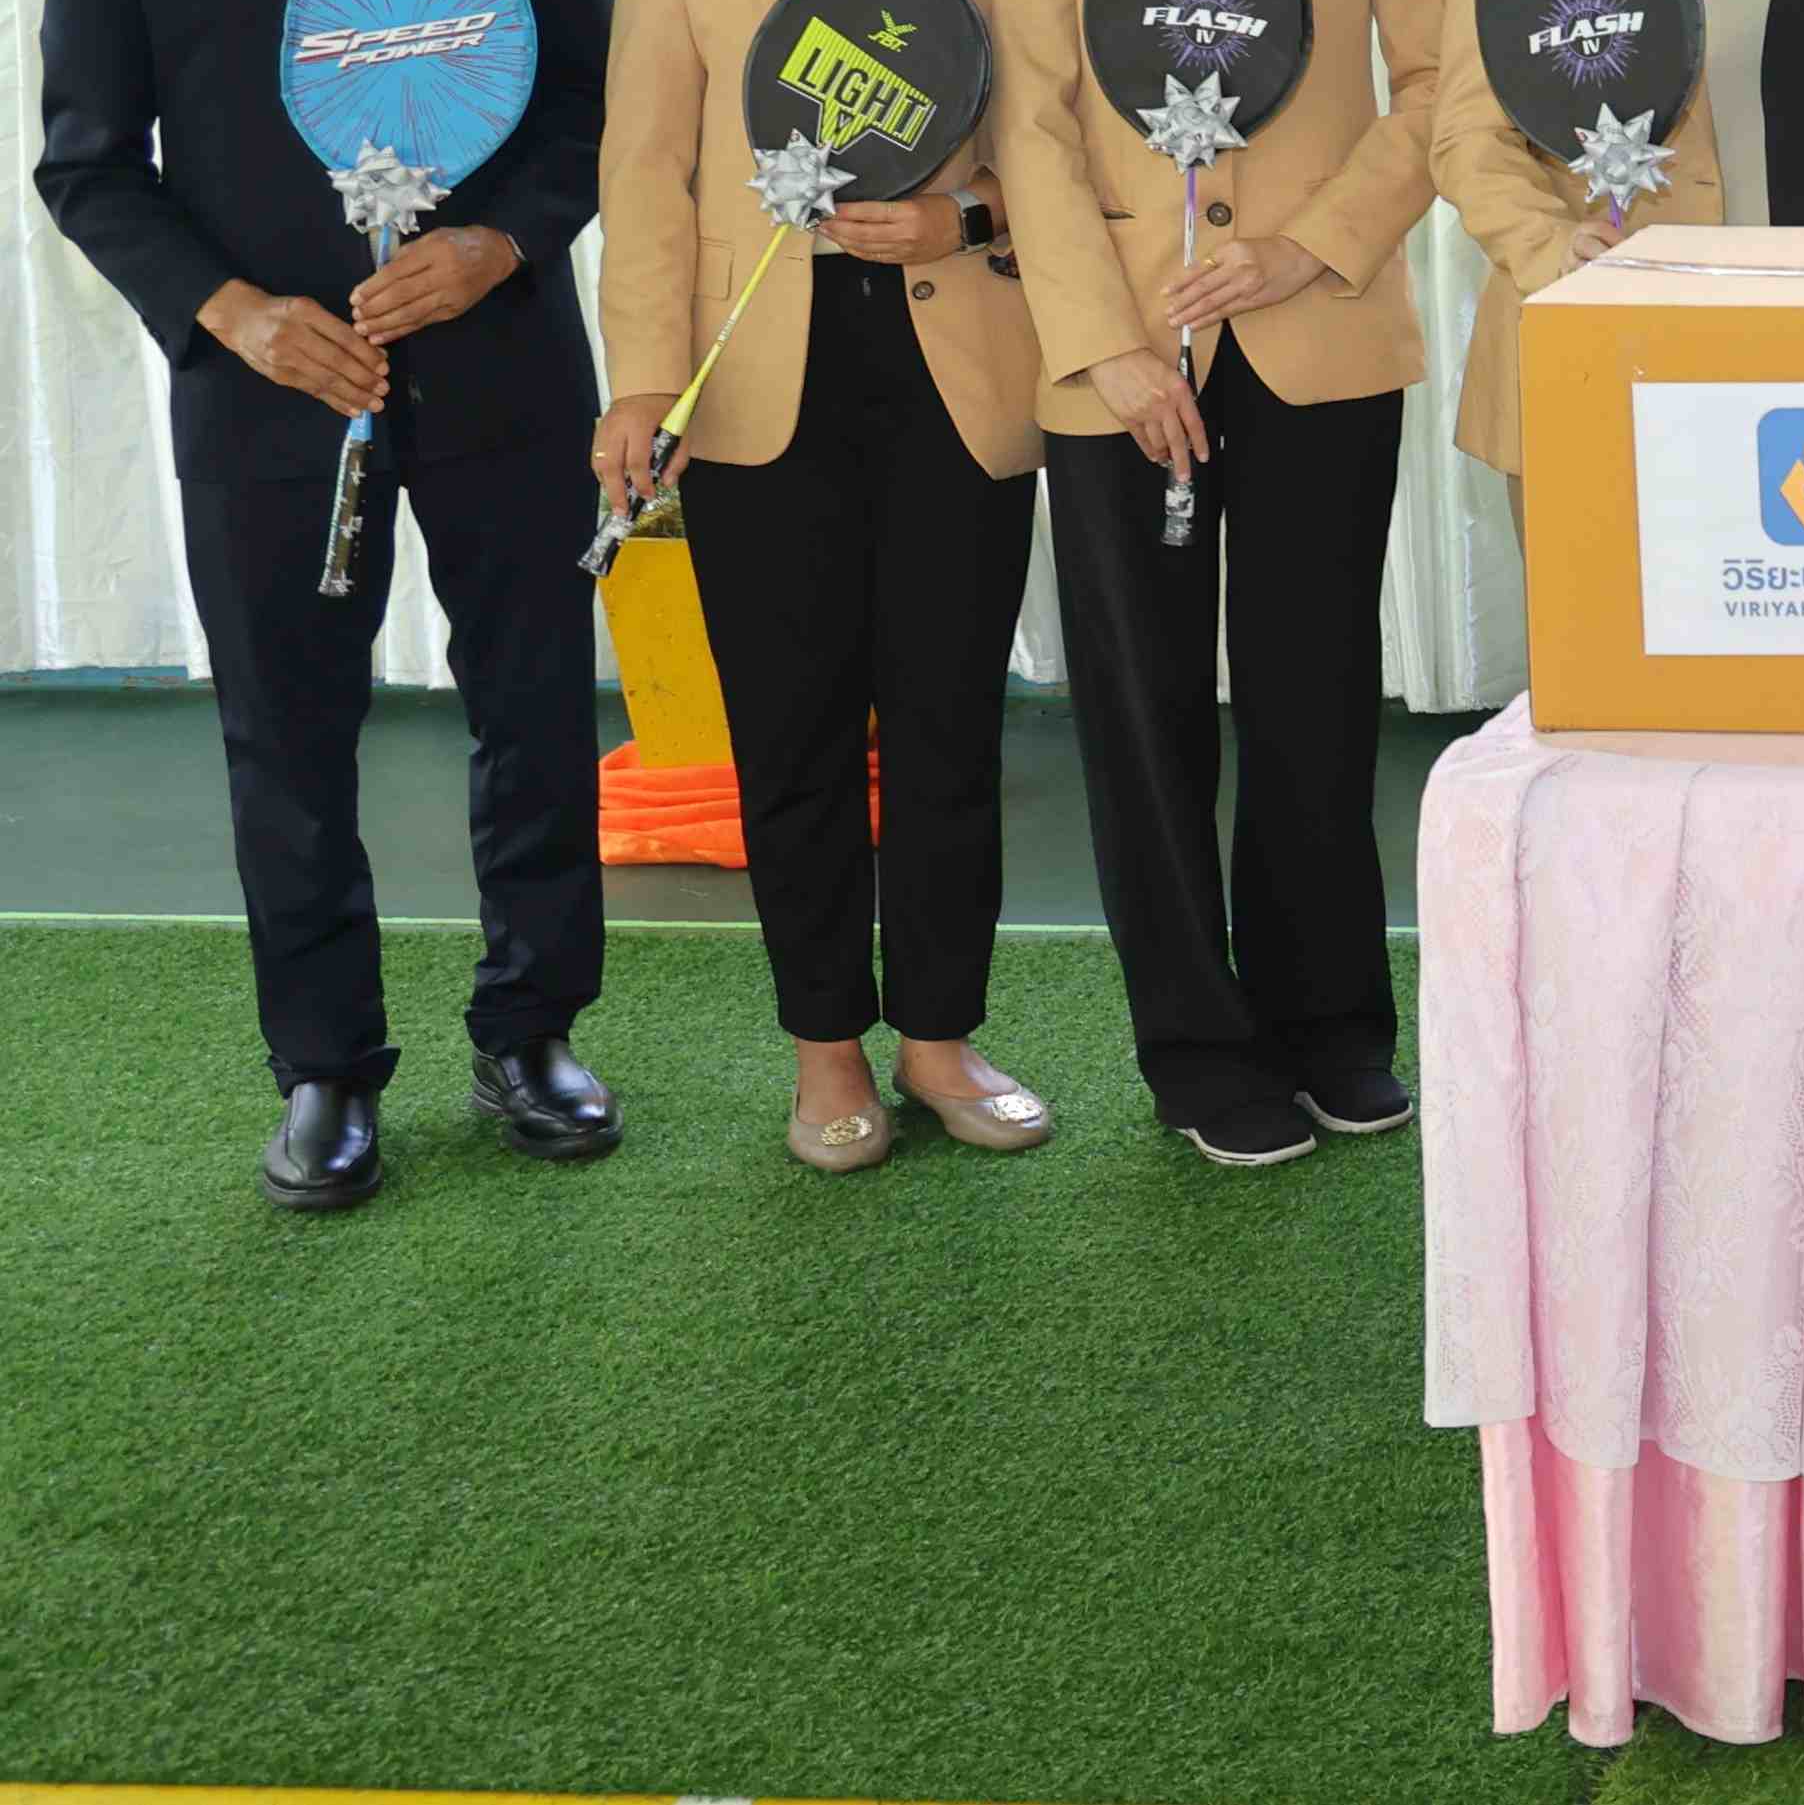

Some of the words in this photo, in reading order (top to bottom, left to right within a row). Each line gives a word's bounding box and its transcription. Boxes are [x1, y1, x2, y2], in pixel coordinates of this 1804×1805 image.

[293, 11, 497, 63] SPEED
[1142, 7, 1269, 38] FLASH
[1528, 11, 1645, 55] FLASH
[336, 31, 486, 69] POWER
[1582, 38, 1601, 56] IV
[798, 47, 928, 143] LIGHT
